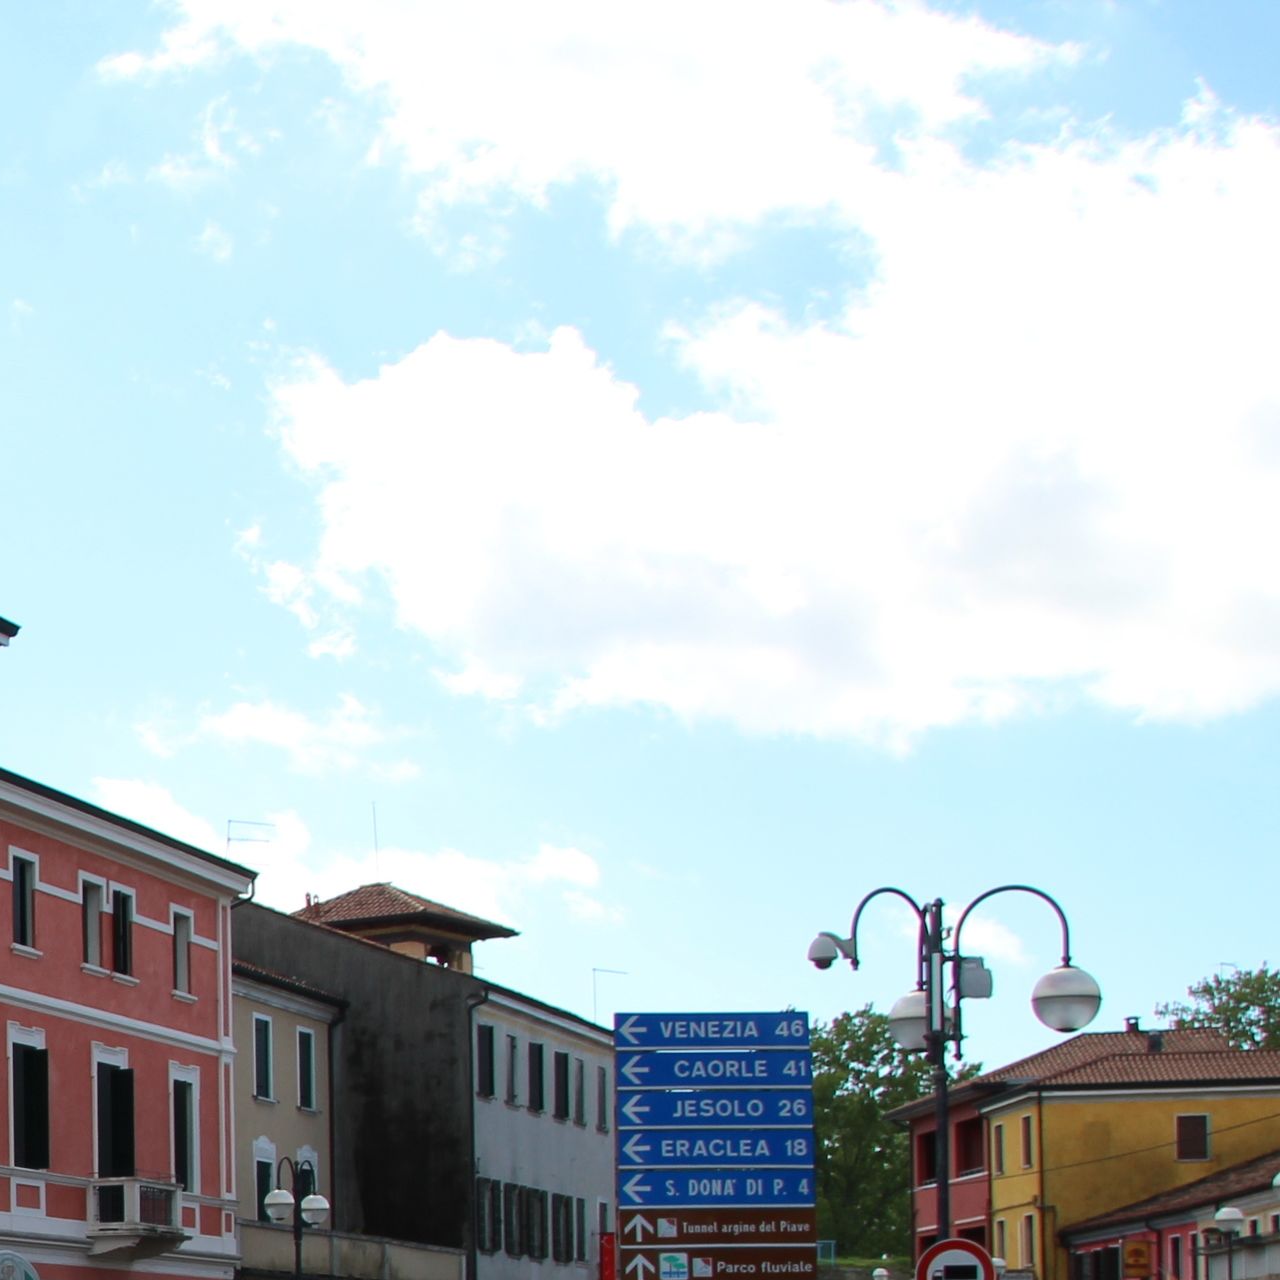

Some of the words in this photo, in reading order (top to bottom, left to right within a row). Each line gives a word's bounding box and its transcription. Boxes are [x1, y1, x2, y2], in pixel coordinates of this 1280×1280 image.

[660, 1021, 759, 1038] VENEZIA
[775, 1020, 804, 1037] 46
[674, 1060, 768, 1077] CAORLE
[783, 1060, 806, 1076] 41
[672, 1100, 763, 1117] JESOLO
[779, 1099, 806, 1116] 26
[661, 1139, 770, 1157] ERACLEA
[785, 1139, 807, 1156] 18
[665, 1180, 680, 1196] S.
[746, 1179, 762, 1196] DI
[774, 1179, 787, 1195] P.
[798, 1179, 808, 1195] 4
[683, 1222, 718, 1233] Tunnel
[721, 1221, 756, 1235] argine
[759, 1221, 776, 1232] del
[780, 1220, 810, 1232] Piave
[717, 1261, 756, 1273] Parco
[761, 1261, 813, 1273] fluviale
